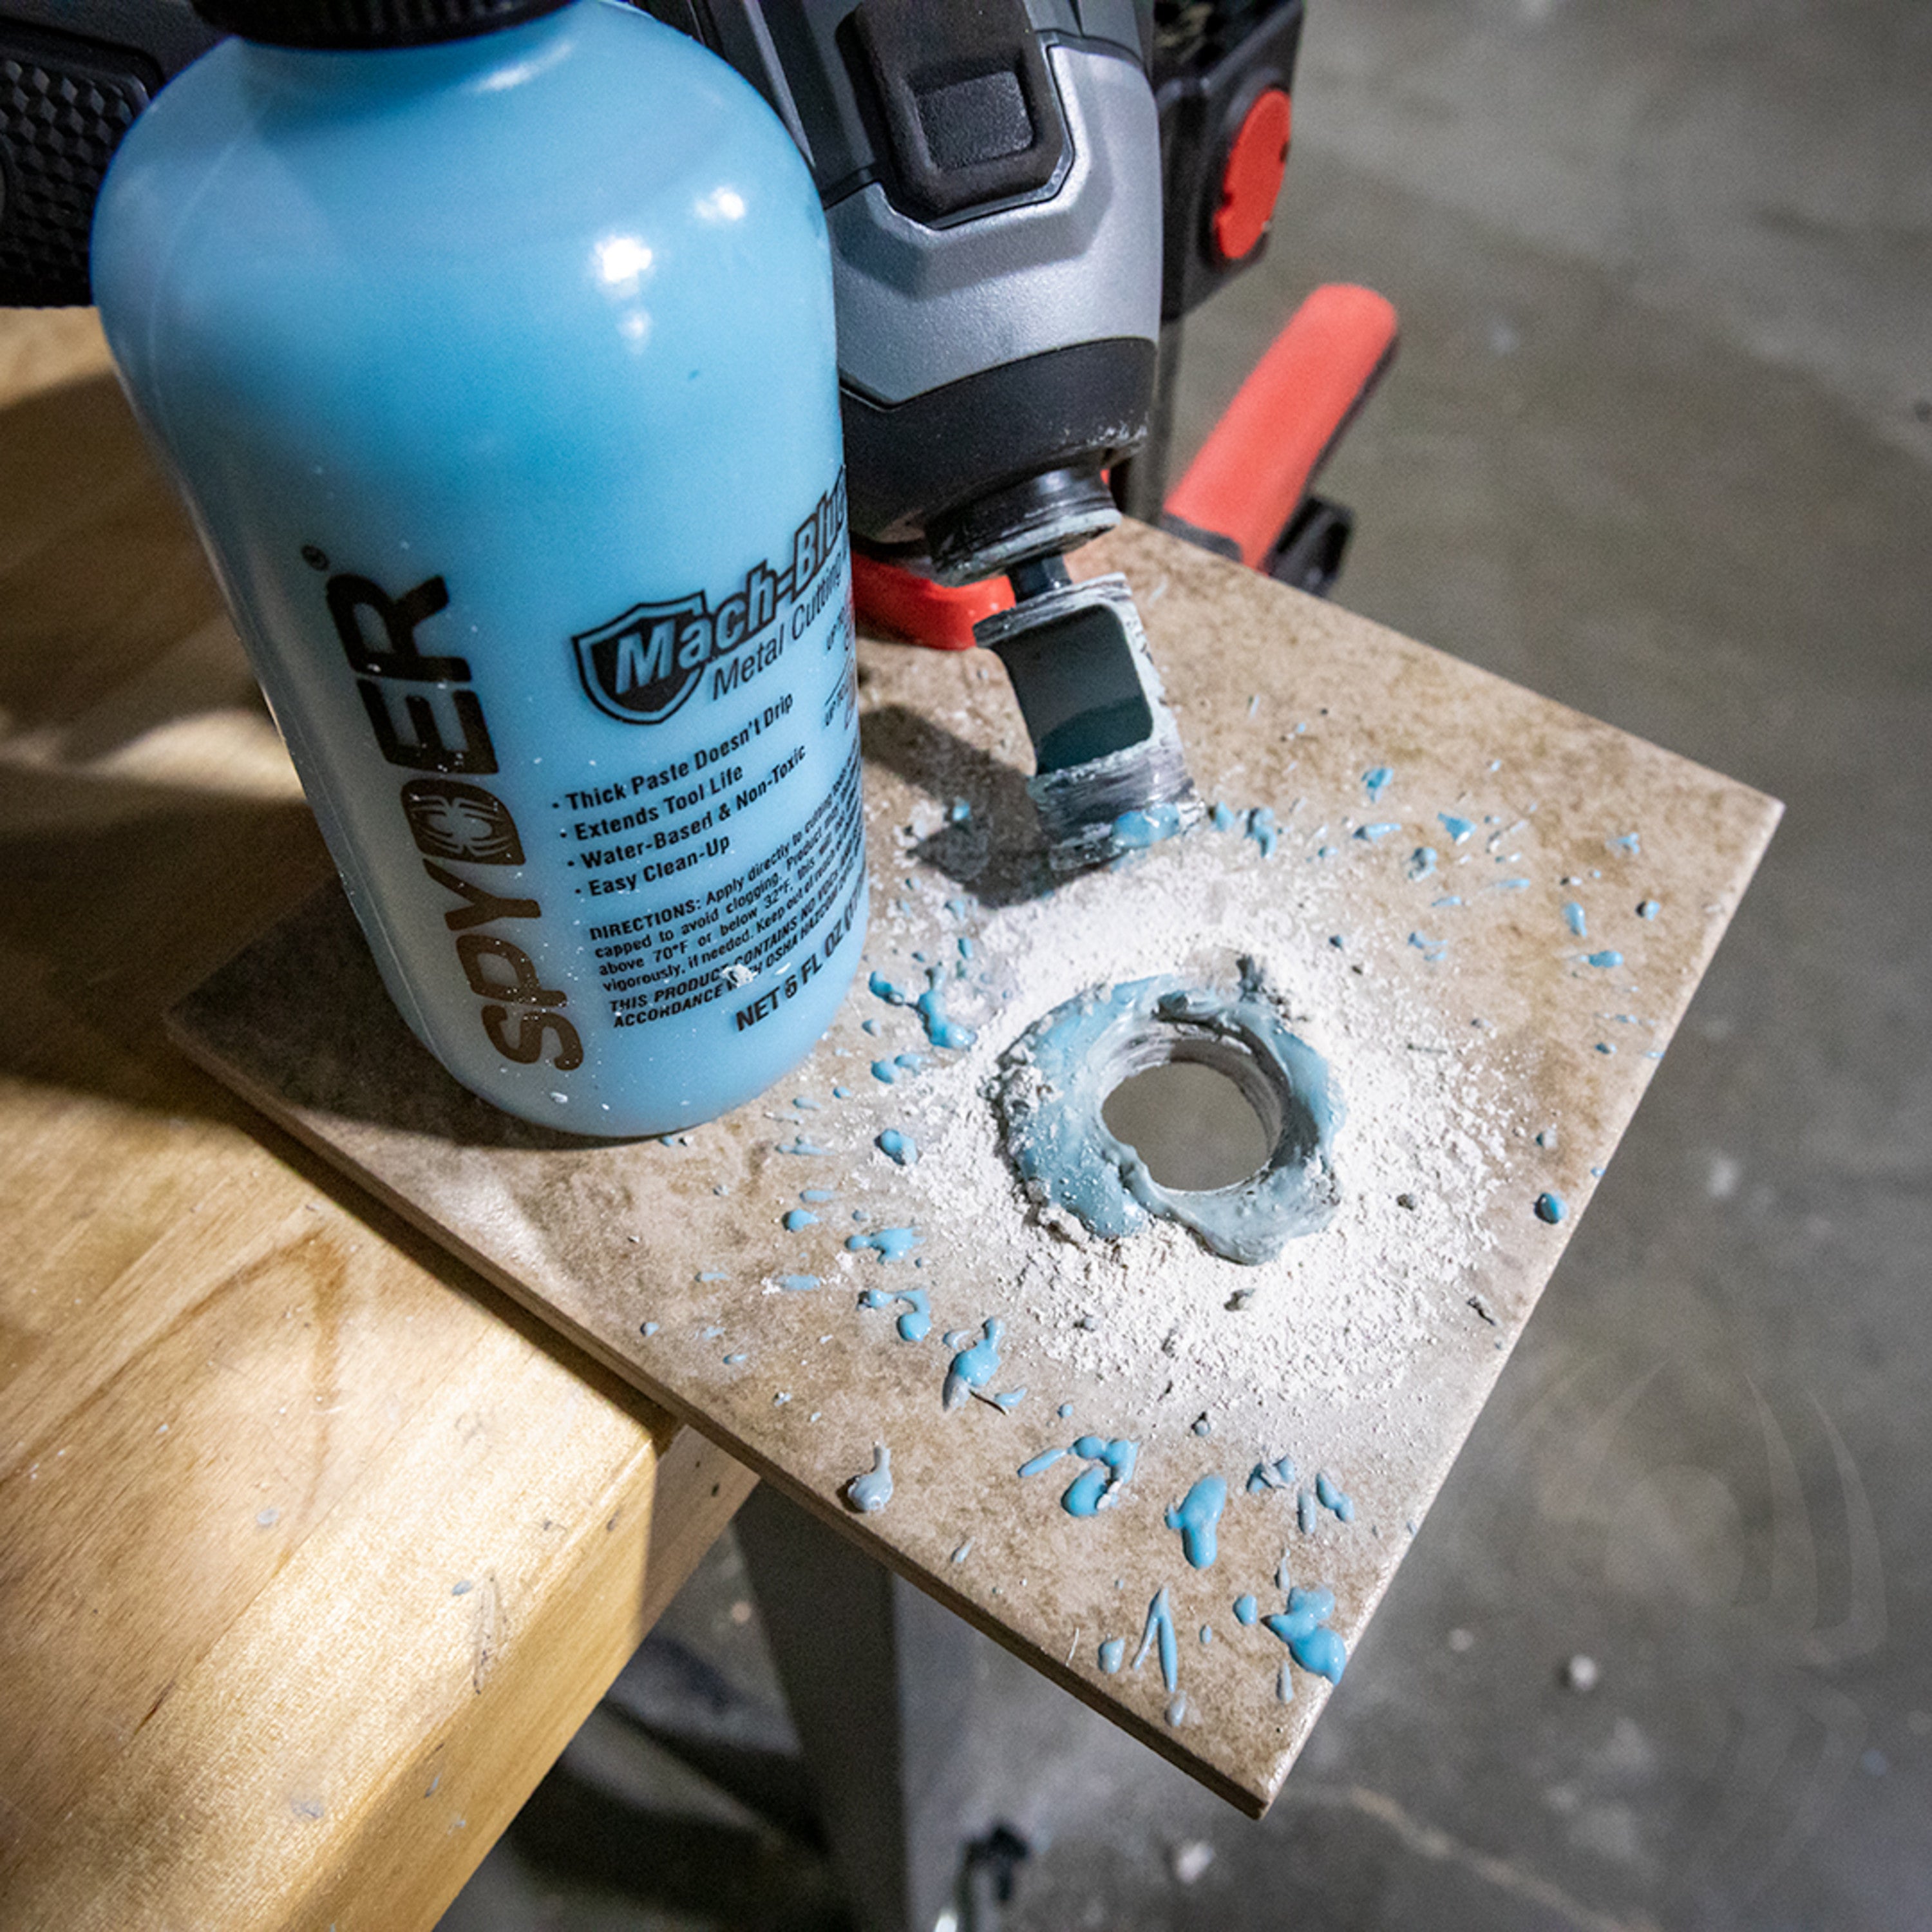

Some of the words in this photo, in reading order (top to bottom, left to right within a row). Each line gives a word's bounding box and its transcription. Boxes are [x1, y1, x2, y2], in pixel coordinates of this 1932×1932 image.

[712, 623, 784, 701] Metal
[565, 782, 627, 811] Thick
[631, 762, 690, 795] Paste
[694, 717, 761, 771] Doesn't
[763, 693, 793, 728] Drip
[326, 573, 585, 1072] SPYDER
[574, 806, 659, 841] Extends
[663, 784, 705, 815] Tool
[710, 766, 743, 795] Life
[580, 810, 713, 869] Water-Based
[718, 802, 732, 822] &
[736, 745, 806, 811] Non-Toxic
[588, 873, 637, 896] Easy
[642, 836, 730, 883] Clean-Up
[589, 899, 702, 941] DIRECTIONS:
[706, 876, 744, 905] Apply
[747, 842, 790, 882] directly
[594, 934, 652, 958] capped
[659, 929, 674, 943] to
[681, 908, 719, 935] avoid
[726, 873, 782, 914] clogging.
[599, 957, 645, 976] above
[652, 940, 688, 963] 70°F
[697, 933, 712, 947] or
[719, 907, 758, 936] below
[688, 955, 699, 969] if
[701, 929, 754, 963] needed.
[755, 907, 786, 933] Keep
[609, 994, 648, 1012] THIS
[734, 916, 798, 966] CONTAINS
[614, 982, 724, 1028] ACCORDANCE
[766, 934, 798, 969] OSHA
[735, 985, 781, 1032] NET
[800, 952, 823, 985] FL
[824, 918, 844, 958] OZ
